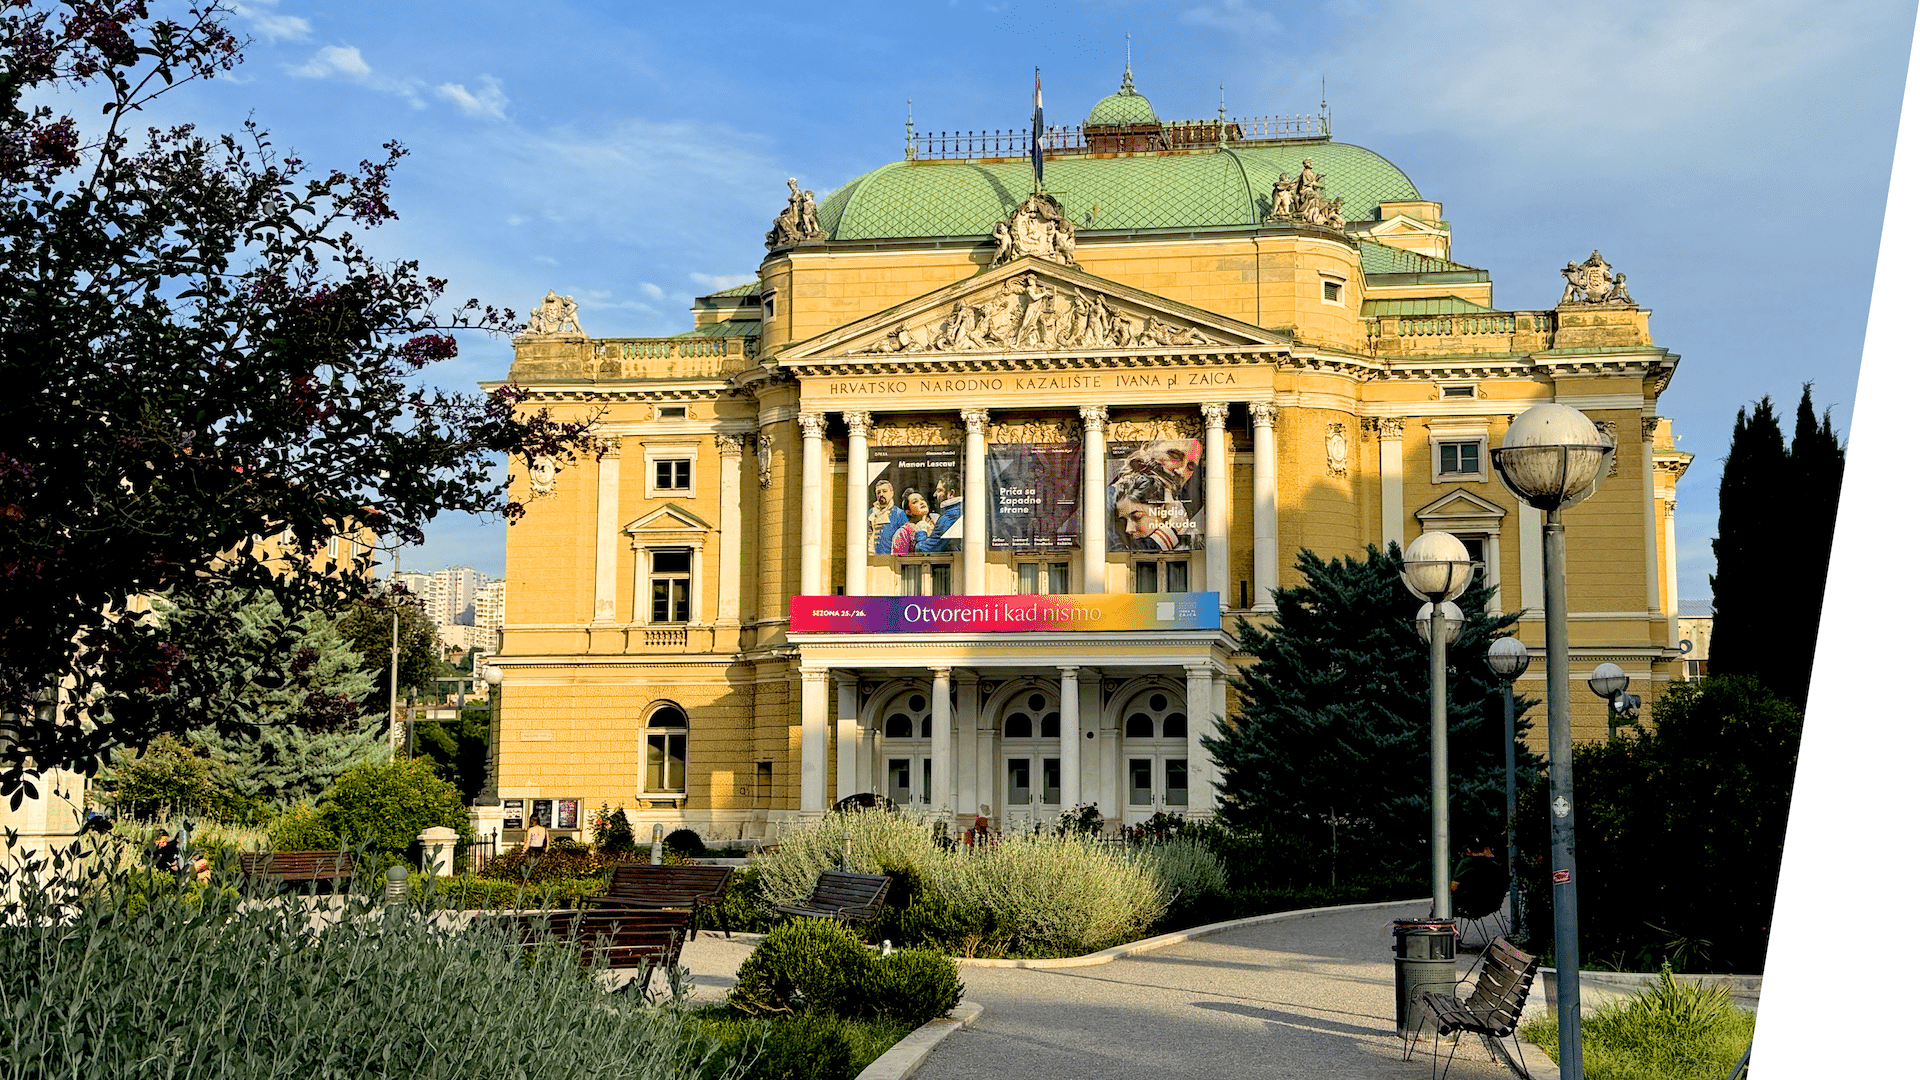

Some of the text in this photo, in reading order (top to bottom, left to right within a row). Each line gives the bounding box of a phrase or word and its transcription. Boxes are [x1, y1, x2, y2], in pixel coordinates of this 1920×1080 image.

[830, 381, 907, 395] HRVATSKO
[920, 378, 1003, 392] NARODNO
[1015, 373, 1101, 390] KAZALIŠTE
[1116, 374, 1161, 387] IVANA
[1188, 372, 1236, 386] ZAJCA
[898, 460, 956, 468] Manon Lescaut
[999, 486, 1023, 496] Priča
[999, 496, 1042, 507] Zapadne
[999, 506, 1029, 514] strane
[1148, 506, 1188, 519] Nigdje,
[1148, 518, 1197, 530] niotkuda
[812, 609, 867, 618] SEZONA 25./26.
[903, 602, 1102, 623] Otvoreni i kad nismo
